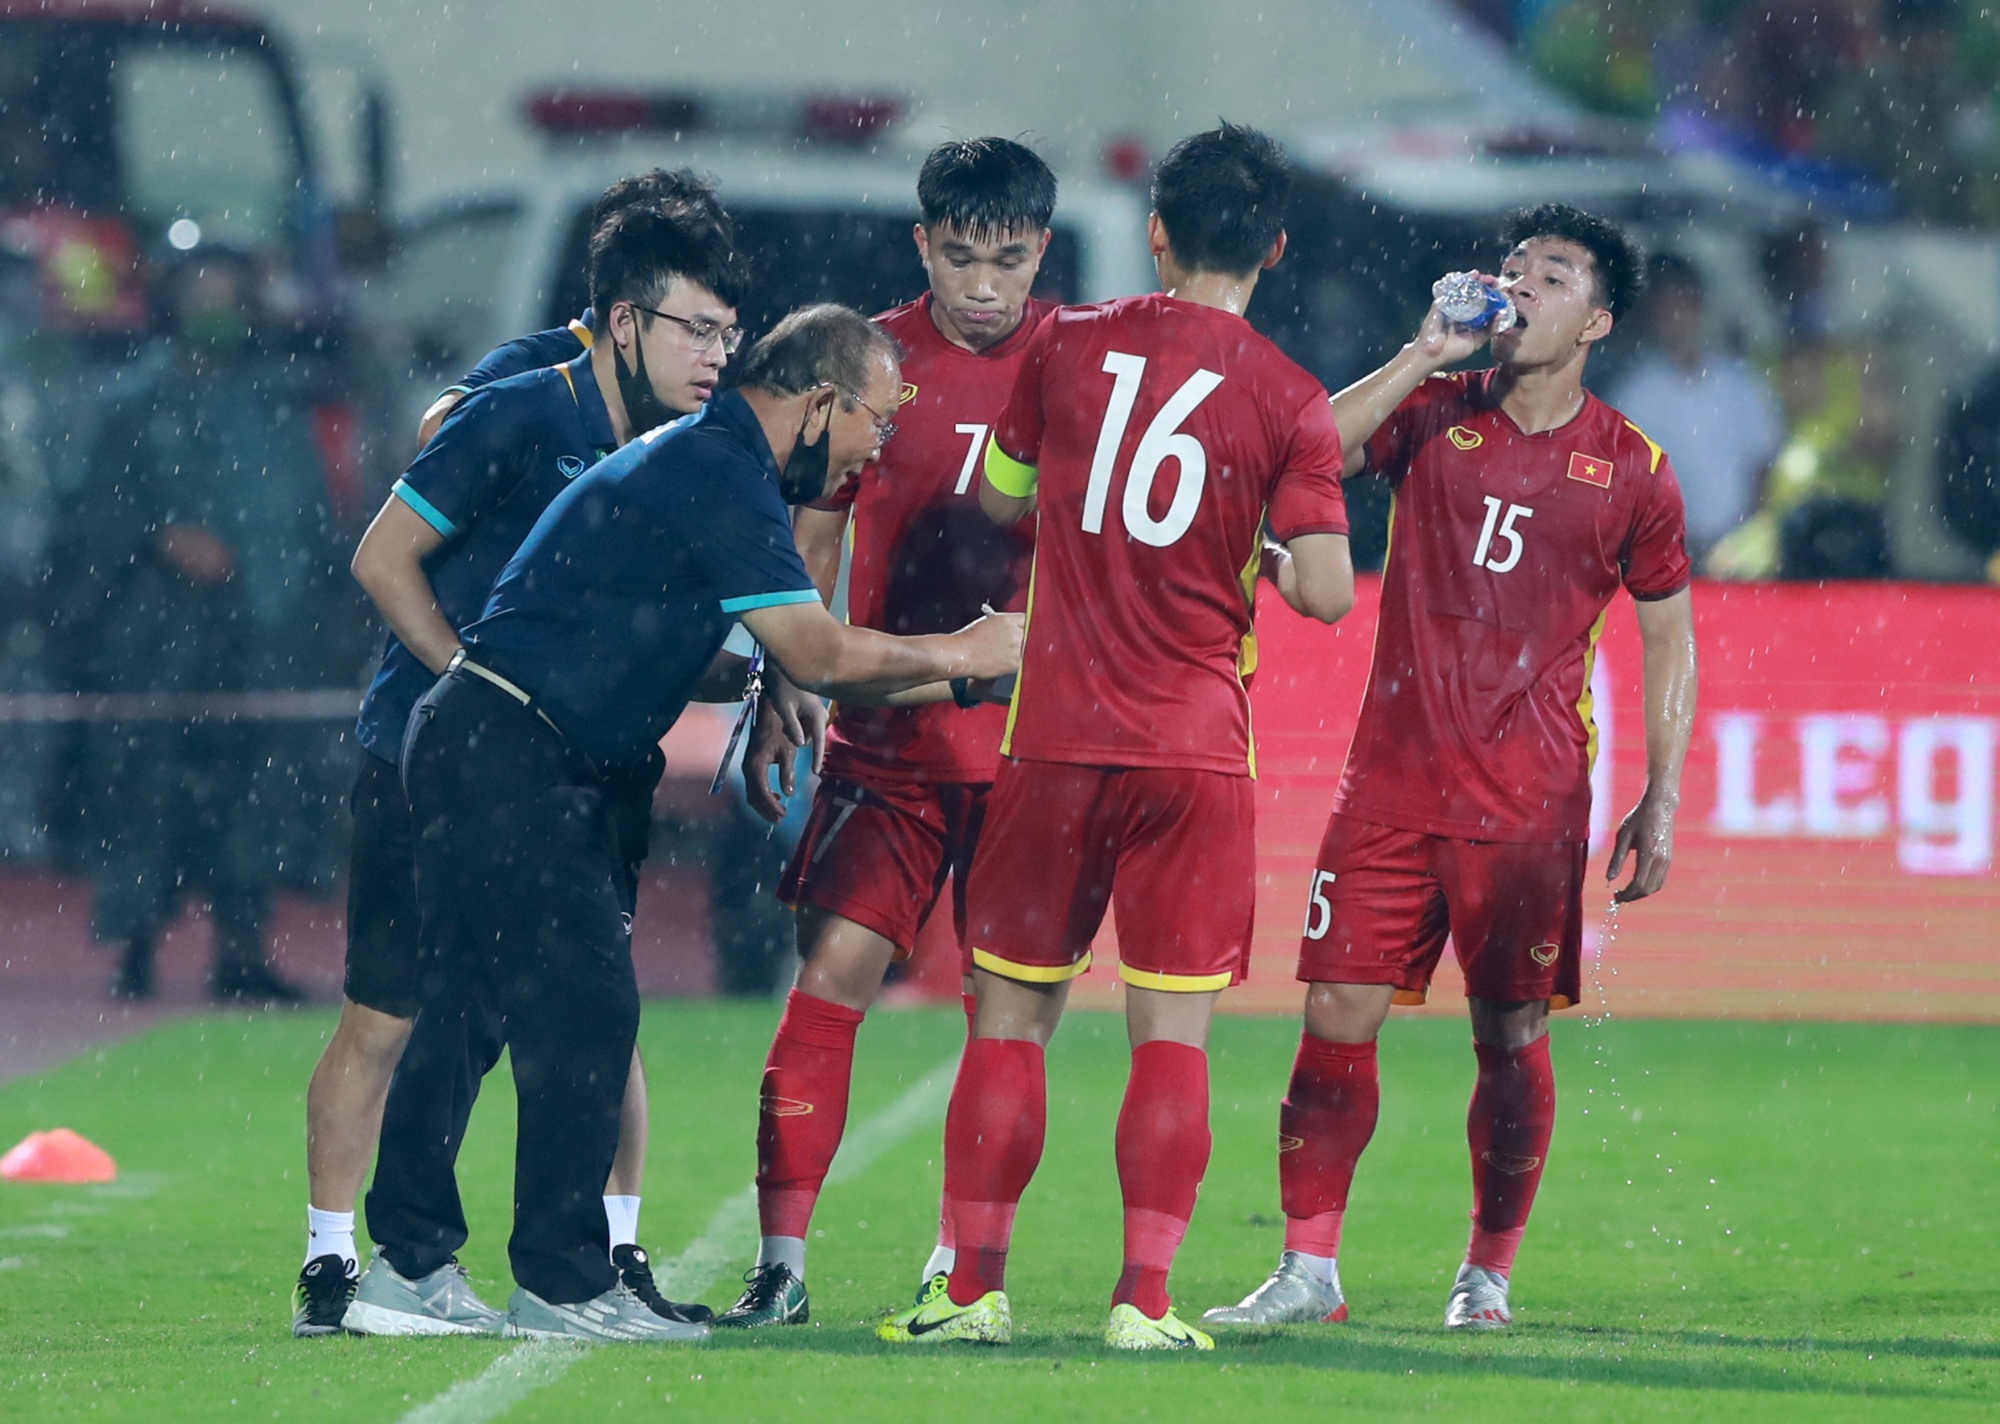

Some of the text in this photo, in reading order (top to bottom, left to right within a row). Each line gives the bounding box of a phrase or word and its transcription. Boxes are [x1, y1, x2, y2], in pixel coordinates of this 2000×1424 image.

[953, 423, 989, 496] 7
[1081, 350, 1225, 547] 16
[1472, 495, 1534, 573] 15
[812, 797, 858, 864] 7
